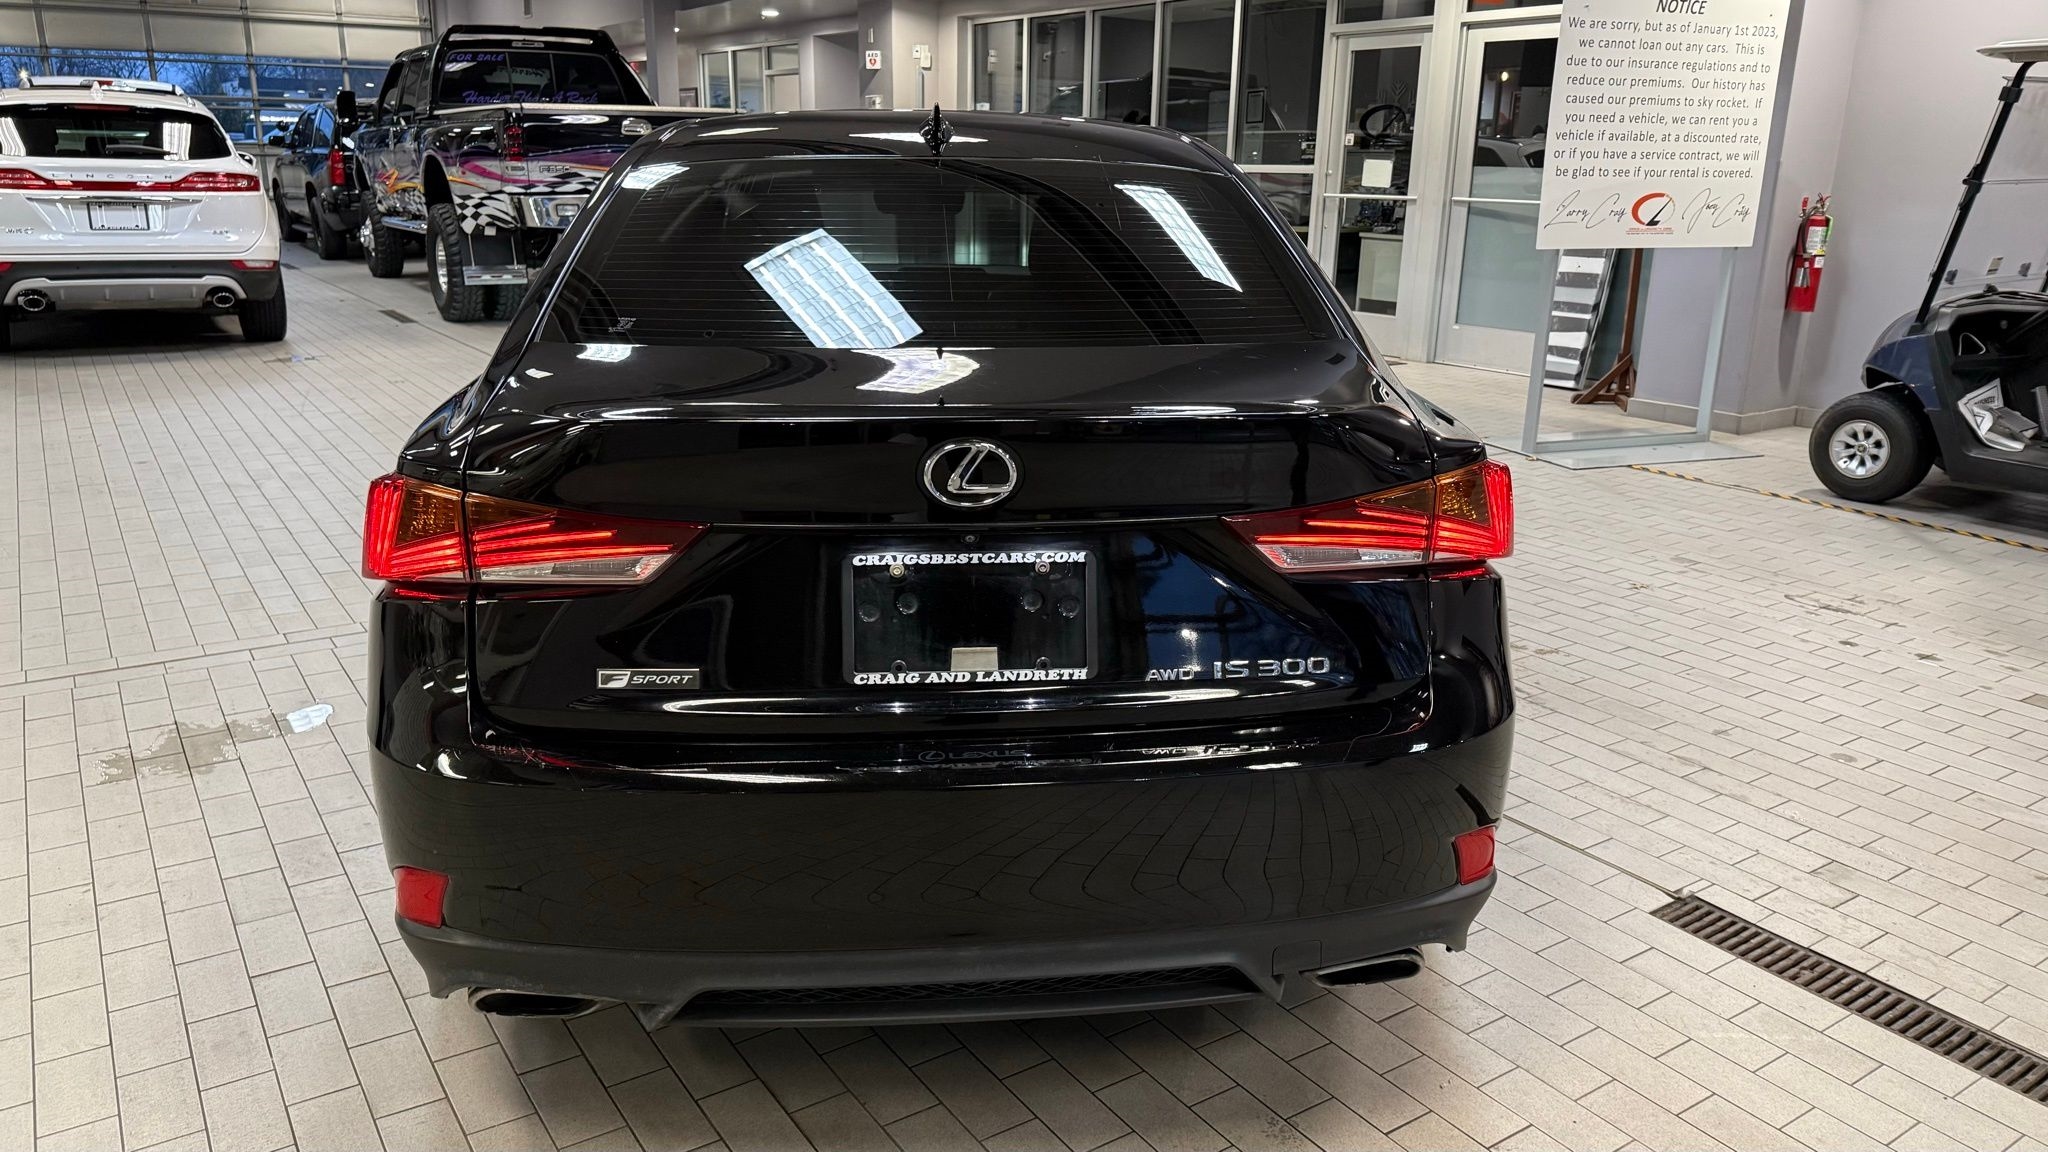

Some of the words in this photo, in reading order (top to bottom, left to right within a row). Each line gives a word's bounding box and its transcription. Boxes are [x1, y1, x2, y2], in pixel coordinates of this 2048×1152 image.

[1569, 16, 1587, 30] We
[1589, 18, 1608, 31] are
[1610, 19, 1641, 34] sorry,
[1645, 19, 1663, 32] but
[1666, 22, 1677, 33] as
[1680, 21, 1691, 33] of
[1693, 22, 1731, 37] January
[1735, 25, 1749, 37] 1st
[1752, 25, 1778, 39] 2023,
[1579, 38, 1595, 48] we
[1598, 39, 1636, 50] cannot
[1639, 38, 1662, 50] loan
[1665, 41, 1682, 51] out
[1686, 43, 1703, 54] any
[1706, 43, 1728, 54] cars.
[1736, 43, 1754, 55] This
[1757, 44, 1765, 55] is
[450, 53, 473, 61] FOR
[477, 53, 505, 61] SALE
[1567, 55, 1588, 67] due
[1590, 56, 1602, 68] to
[1606, 59, 1625, 69] our
[1628, 56, 1678, 71] insurance
[1682, 60, 1736, 73] regulations
[1740, 62, 1758, 73] and
[1761, 63, 1770, 73] to
[1567, 75, 1605, 87] reduce
[1608, 76, 1627, 87] our
[1629, 76, 1685, 90] premiums.
[1692, 78, 1710, 89] Our
[1713, 78, 1746, 93] history
[1749, 80, 1765, 91] has
[566, 91, 599, 104] Rock
[1565, 92, 1604, 105] caused
[1607, 95, 1626, 105] our
[1629, 95, 1681, 109] premiums
[1684, 97, 1694, 107] to
[1697, 96, 1713, 109] sky
[1716, 97, 1748, 108] rocket.
[1755, 98, 1763, 108] If
[1564, 112, 1586, 125] you
[1589, 112, 1616, 124] need
[1619, 115, 1625, 124] a
[1629, 112, 1668, 127] vehicle,
[1672, 116, 1686, 125] we
[1689, 116, 1706, 125] can
[1709, 116, 1729, 126] rent
[1732, 118, 1749, 129] you
[1752, 118, 1757, 126] a
[1556, 129, 1595, 142] vehicle
[1596, 130, 1606, 142] if
[1608, 130, 1658, 144] available,
[1661, 132, 1672, 142] at
[1674, 134, 1680, 142] a
[1683, 131, 1737, 143] discounted
[1740, 134, 1761, 145] rate,
[1554, 149, 1567, 159] or
[1568, 148, 1578, 159] if
[1580, 150, 1599, 162] you
[1603, 148, 1627, 160] have
[1631, 151, 1636, 159] a
[1640, 149, 1676, 160] service
[1679, 151, 1722, 162] contract,
[1726, 152, 1739, 160] we
[1743, 150, 1759, 160] will
[1555, 165, 1569, 178] be
[1571, 165, 1595, 180] glad
[1598, 167, 1609, 178] to
[1612, 168, 1630, 178] see
[1633, 166, 1641, 178] if
[1643, 169, 1667, 180] your
[1669, 167, 1699, 179] rental
[1702, 167, 1710, 178] is
[1713, 167, 1753, 178] covered.
[852, 552, 1087, 566] CRAIGSBESTCARS.COM
[853, 672, 920, 685] CRAIG
[925, 671, 971, 683] AND
[975, 669, 1088, 683] LANDRETH
[1145, 667, 1196, 682] AWD
[1213, 660, 1250, 680] IS
[1257, 657, 1331, 677] 300
[631, 675, 694, 684] SPORT
